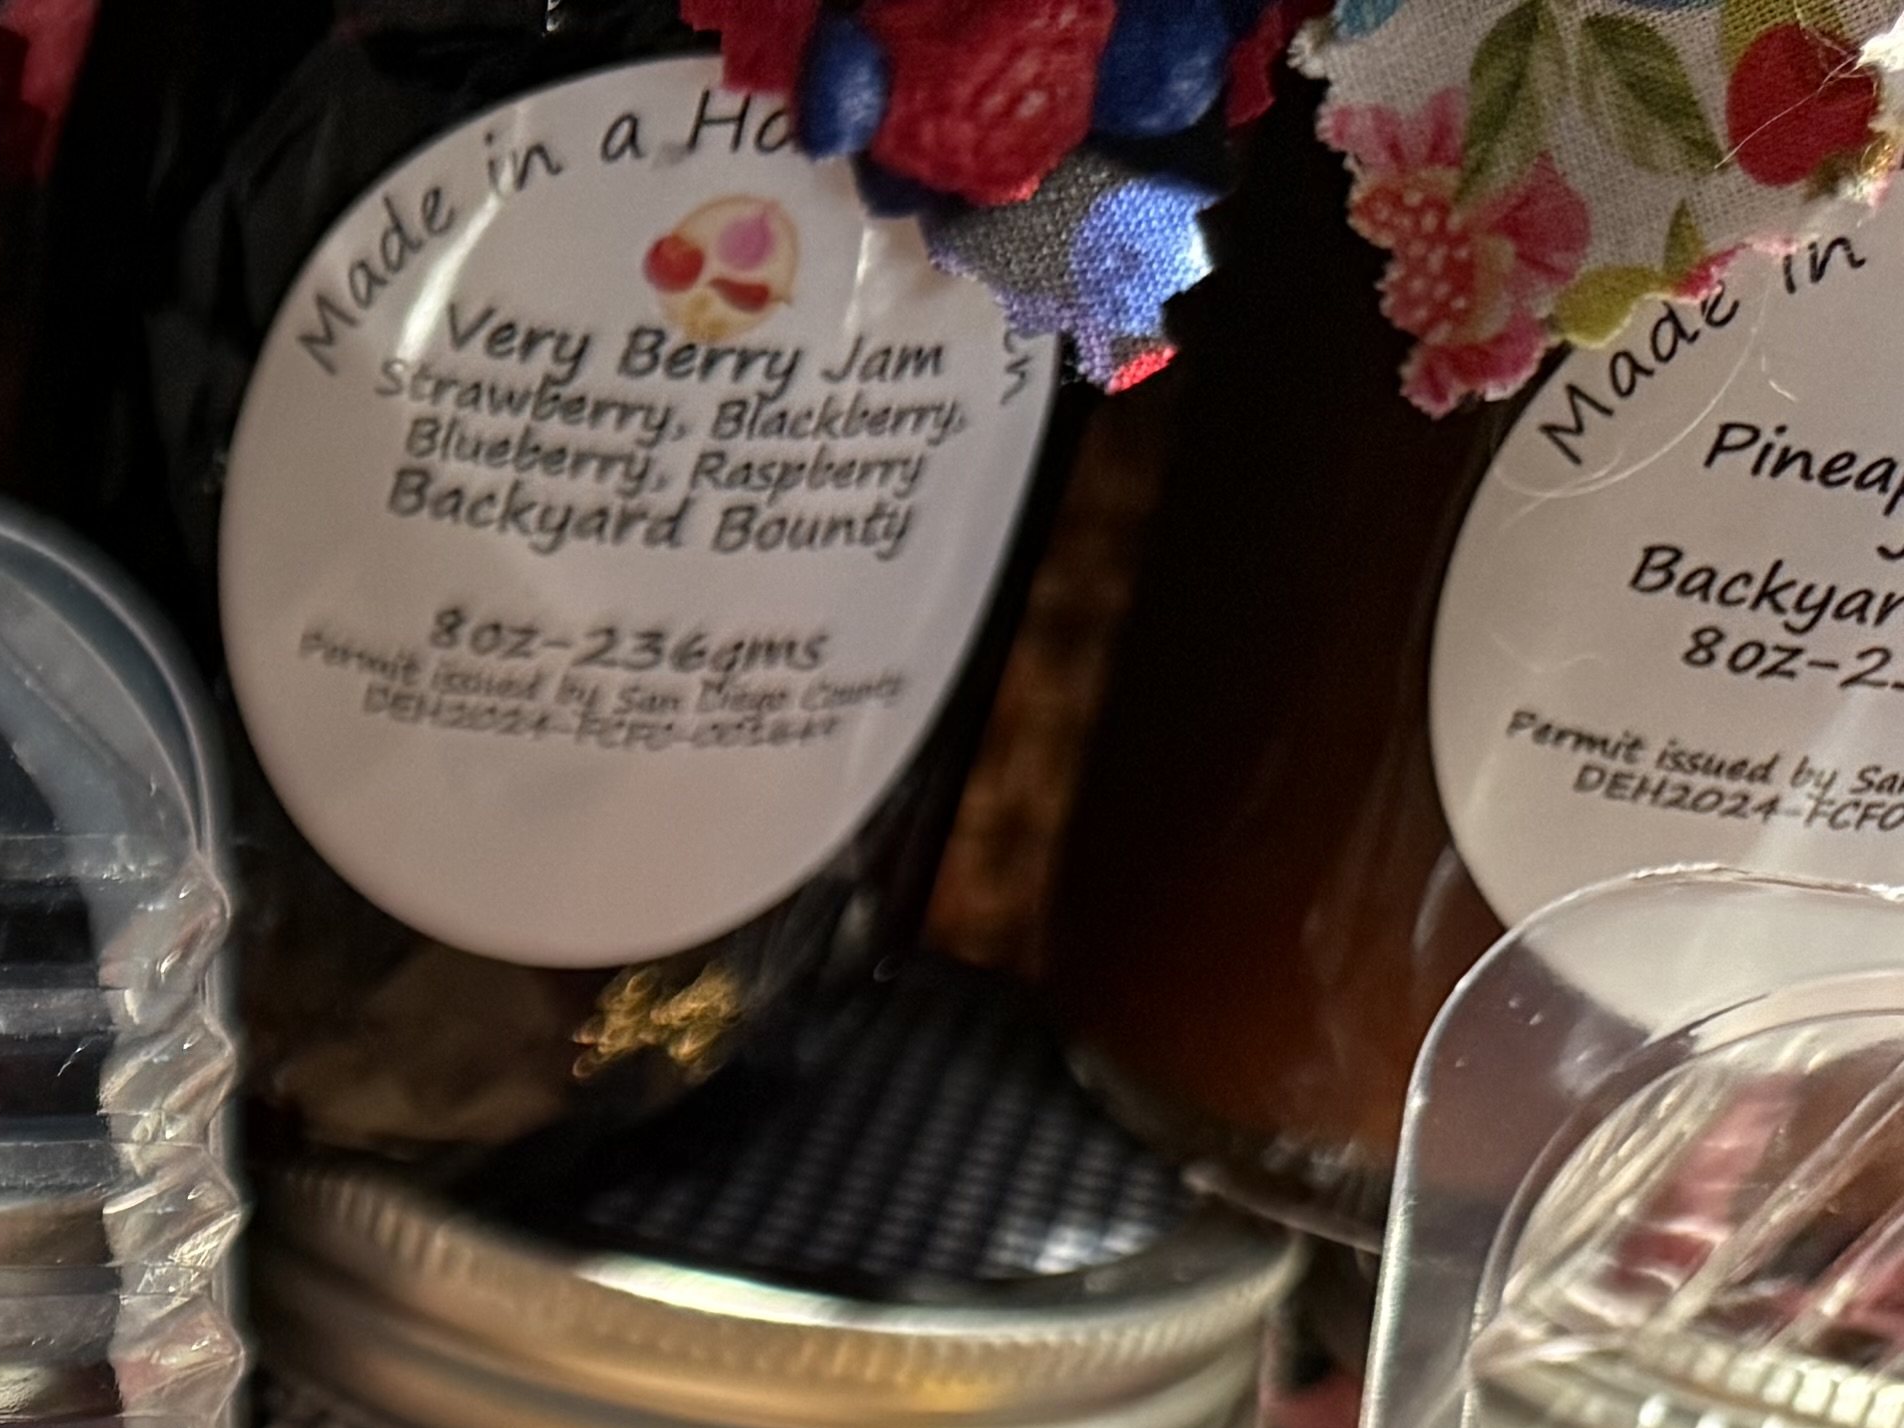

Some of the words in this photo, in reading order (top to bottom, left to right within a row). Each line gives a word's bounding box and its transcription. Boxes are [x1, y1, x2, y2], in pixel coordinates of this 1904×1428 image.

[297, 183, 456, 376] Made
[483, 131, 563, 194] in
[600, 111, 642, 161] a
[686, 89, 793, 155] Ho
[446, 303, 592, 383] Very
[618, 326, 803, 387] Berry
[822, 334, 945, 385] Jam
[1537, 281, 1741, 466] Made
[1781, 236, 1868, 294] in
[374, 358, 690, 443] Strawberry,
[709, 383, 969, 444] Blackberry,
[405, 415, 668, 496] Blueberry,
[689, 449, 926, 500] Raspberry
[387, 469, 688, 556] Backyard
[711, 501, 913, 562] Bounty
[1680, 625, 1904, 690] 8oz-2
[1504, 709, 1643, 765] Permit
[1654, 737, 1780, 785] issued
[1789, 754, 1838, 802] by
